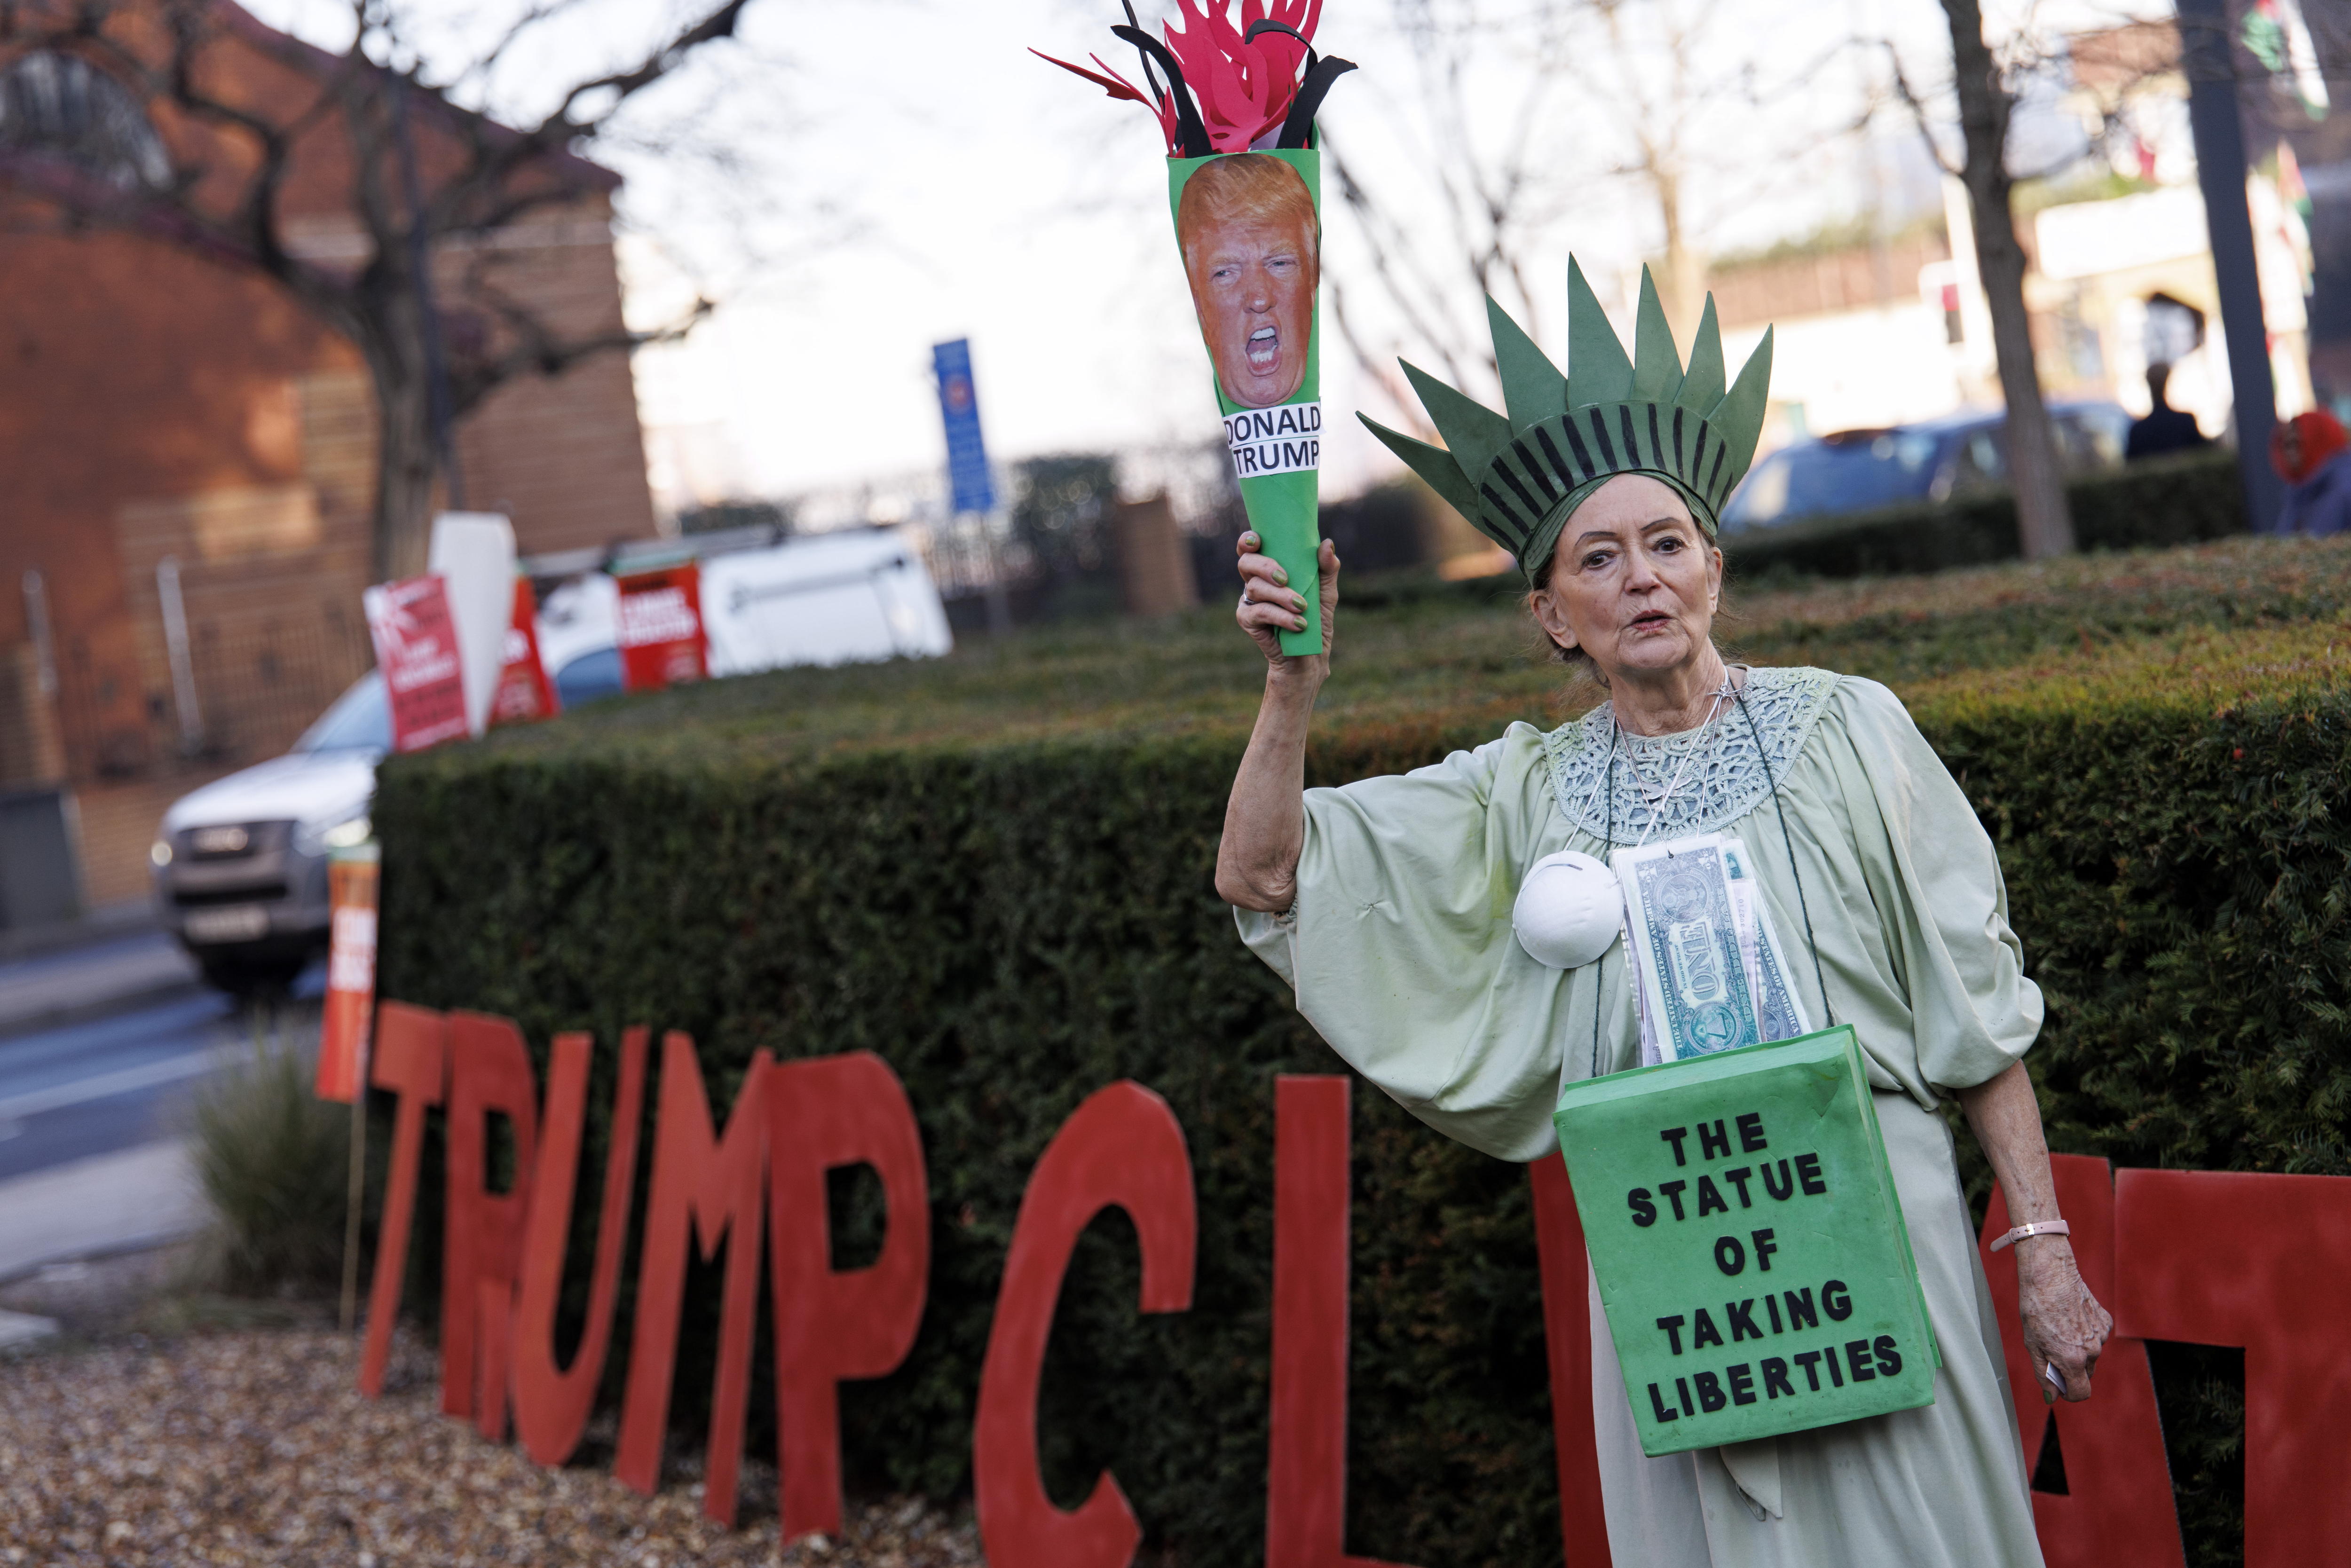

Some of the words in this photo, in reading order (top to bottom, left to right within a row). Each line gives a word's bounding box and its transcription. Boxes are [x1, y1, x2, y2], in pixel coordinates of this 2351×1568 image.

[1223, 406, 1321, 445] DONALD
[1233, 440, 1319, 474] TRUMP
[1642, 890, 1657, 936] AMERICA
[1717, 887, 1742, 975] DOLLAR
[1652, 935, 1661, 951] OF
[1678, 961, 1683, 970] WE
[1679, 921, 1720, 1001] ONE
[1655, 951, 1670, 989] STATES
[1759, 938, 1778, 976] STATES
[1773, 975, 1783, 989] OF
[1778, 988, 1799, 1034] AMERICA
[1664, 989, 1678, 1027] UNITED
[1736, 977, 1752, 1022] ONE
[1673, 1028, 1683, 1050] THE
[1660, 1112, 1767, 1166] THE
[1628, 1153, 1827, 1228] STATUE
[357, 999, 930, 1545] TRUMP
[1714, 1228, 1777, 1276] OF
[1656, 1279, 1853, 1355] TAKING
[1648, 1335, 1902, 1423] LIBERTIES
